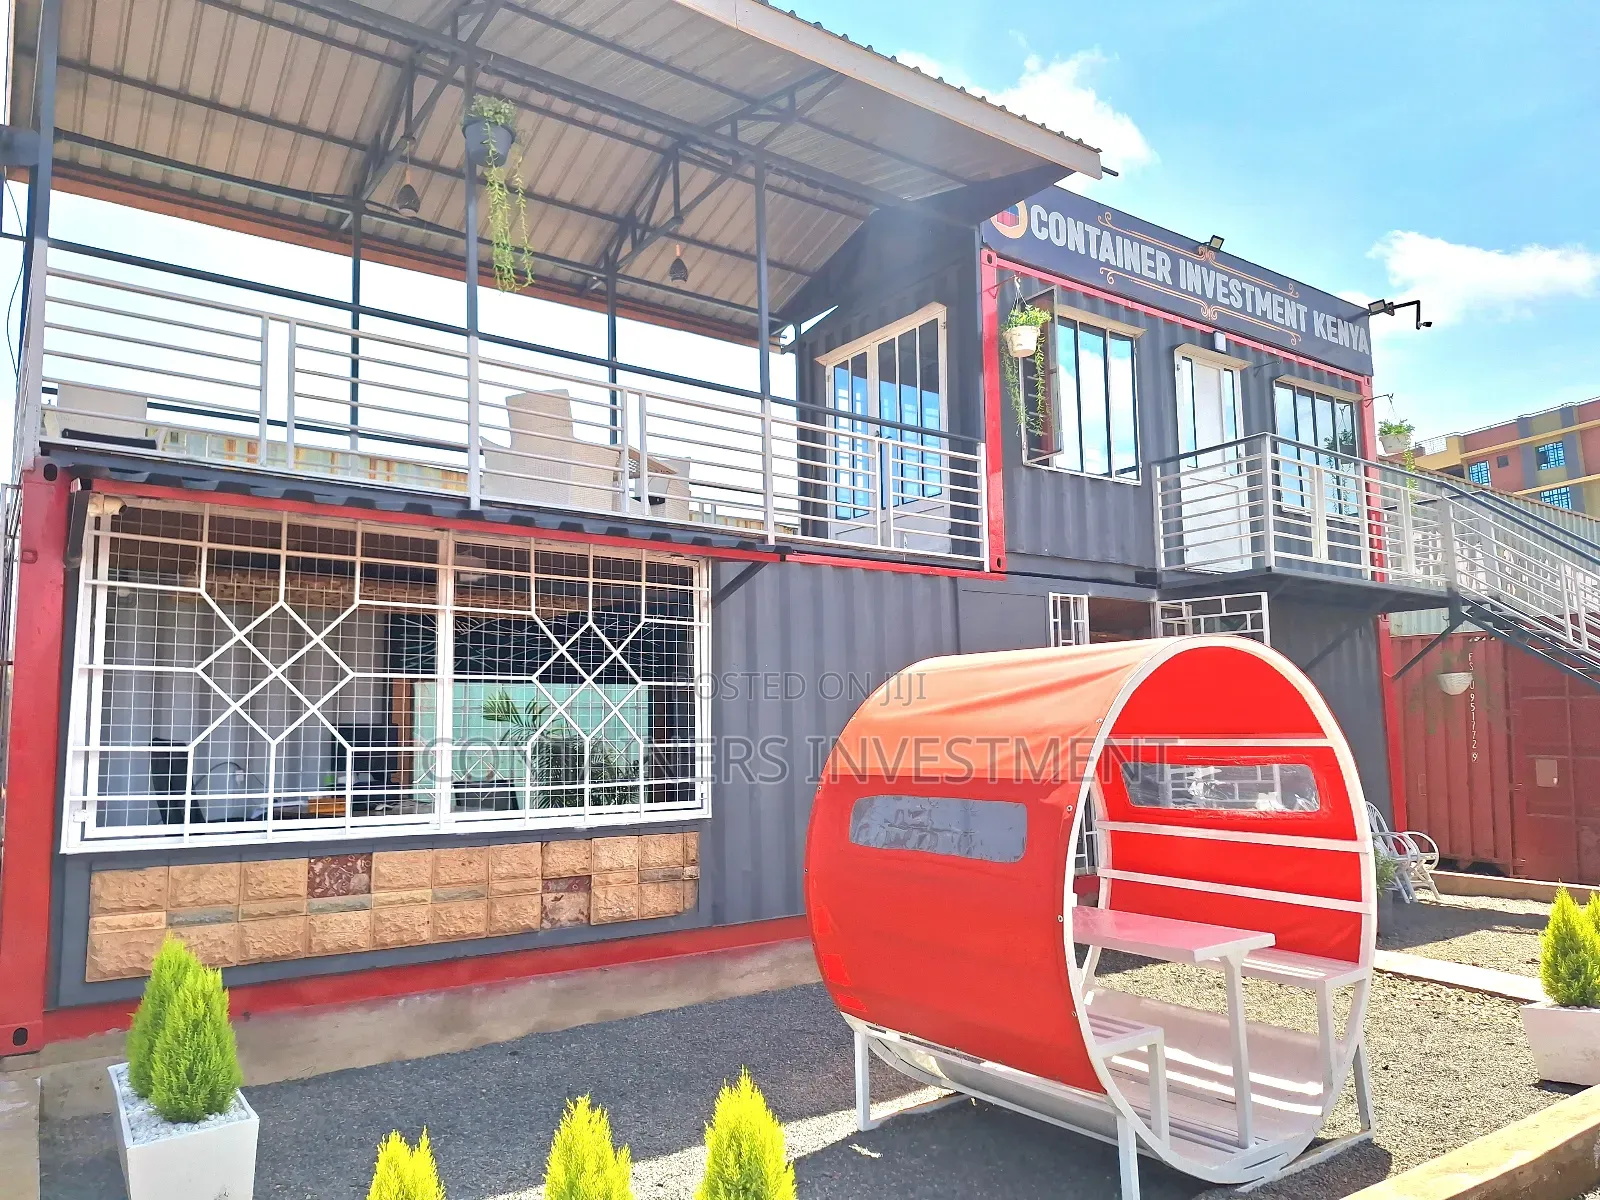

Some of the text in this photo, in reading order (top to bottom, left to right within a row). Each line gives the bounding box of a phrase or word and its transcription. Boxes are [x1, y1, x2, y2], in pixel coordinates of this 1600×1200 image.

[1030, 205, 1370, 355] CONTAINER INVESTMENT KENYA
